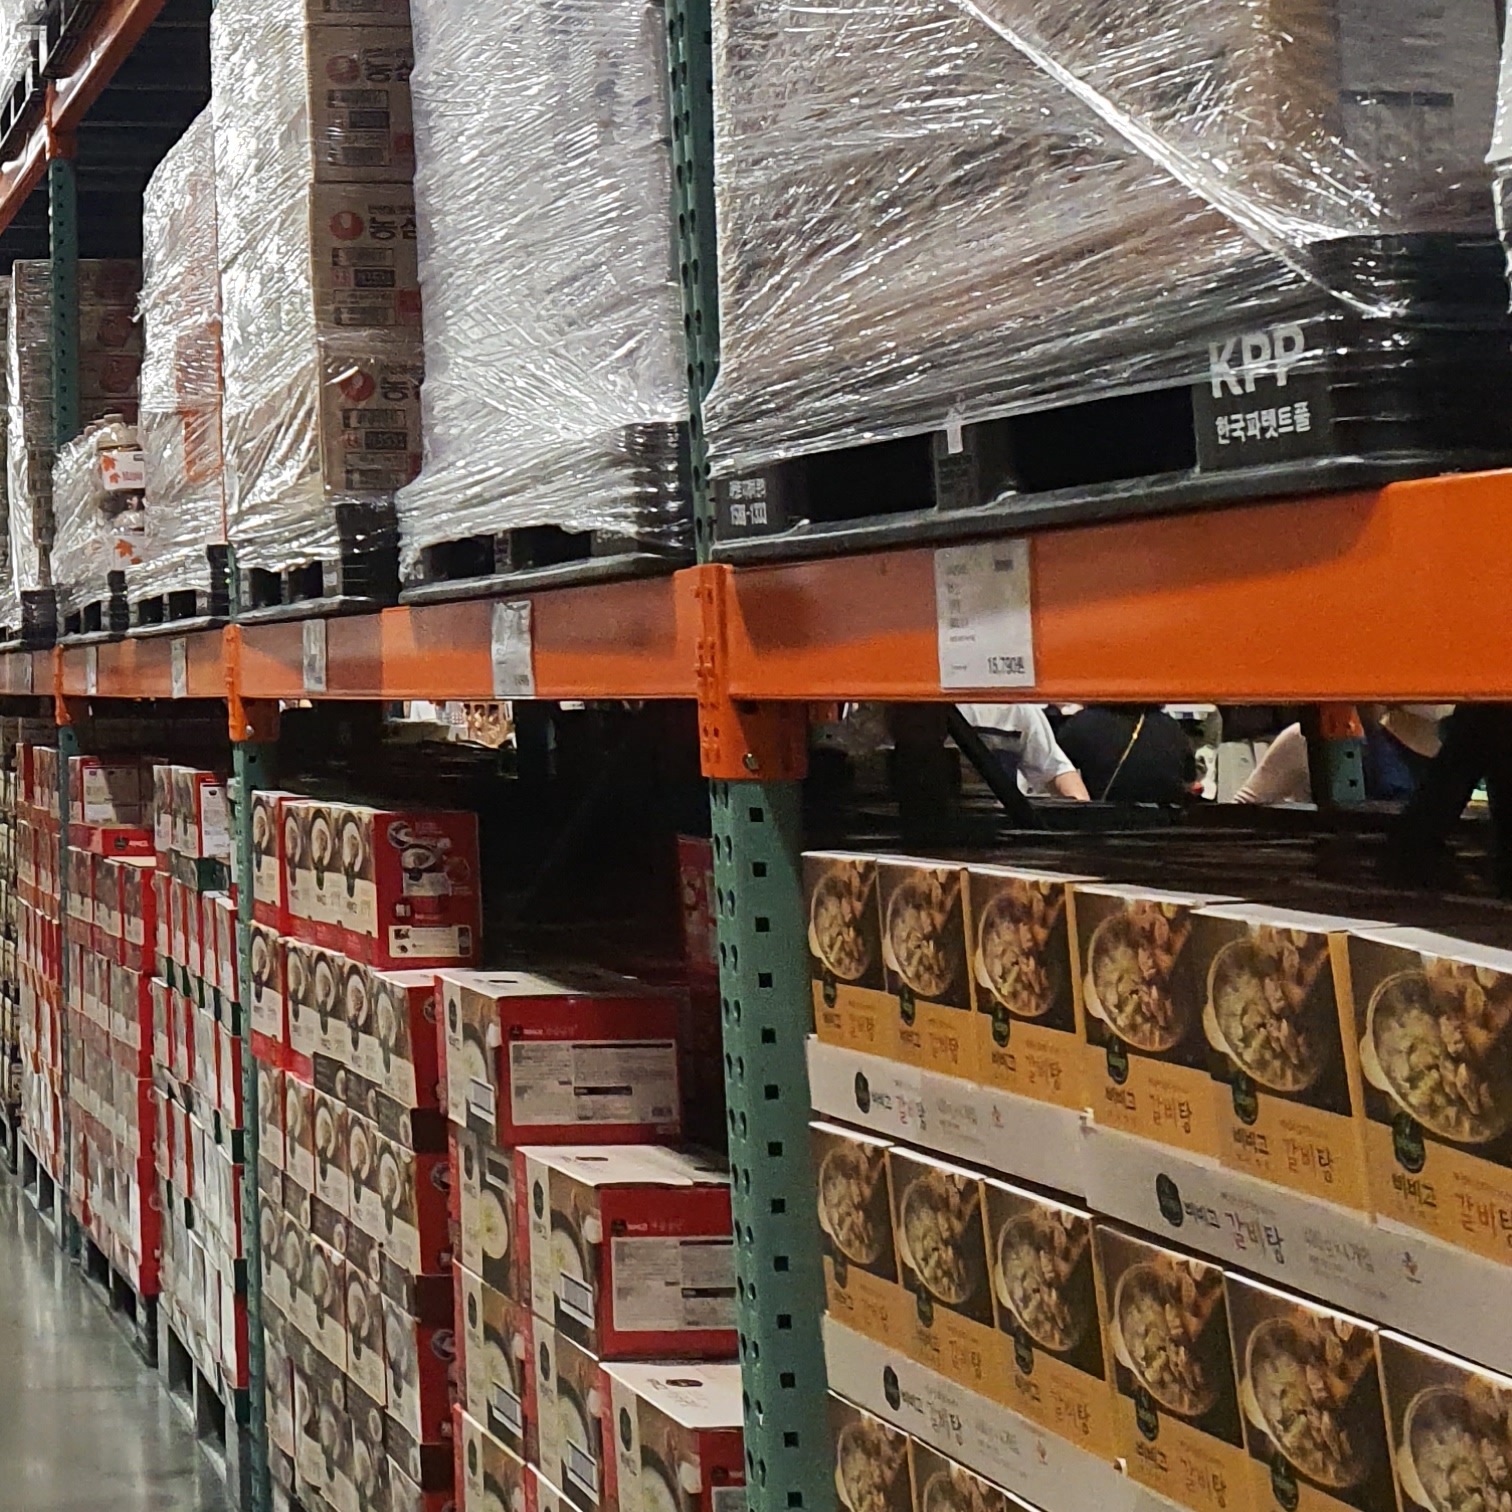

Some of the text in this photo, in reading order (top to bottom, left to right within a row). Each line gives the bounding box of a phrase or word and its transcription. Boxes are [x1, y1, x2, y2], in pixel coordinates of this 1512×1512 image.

[1208, 322, 1306, 399] KPP
[1148, 1093, 1193, 1134] 갈비탕
[1283, 1138, 1334, 1184] 갈비탕
[1391, 1173, 1438, 1208] 비비고
[1224, 1211, 1285, 1265] 갈비탕
